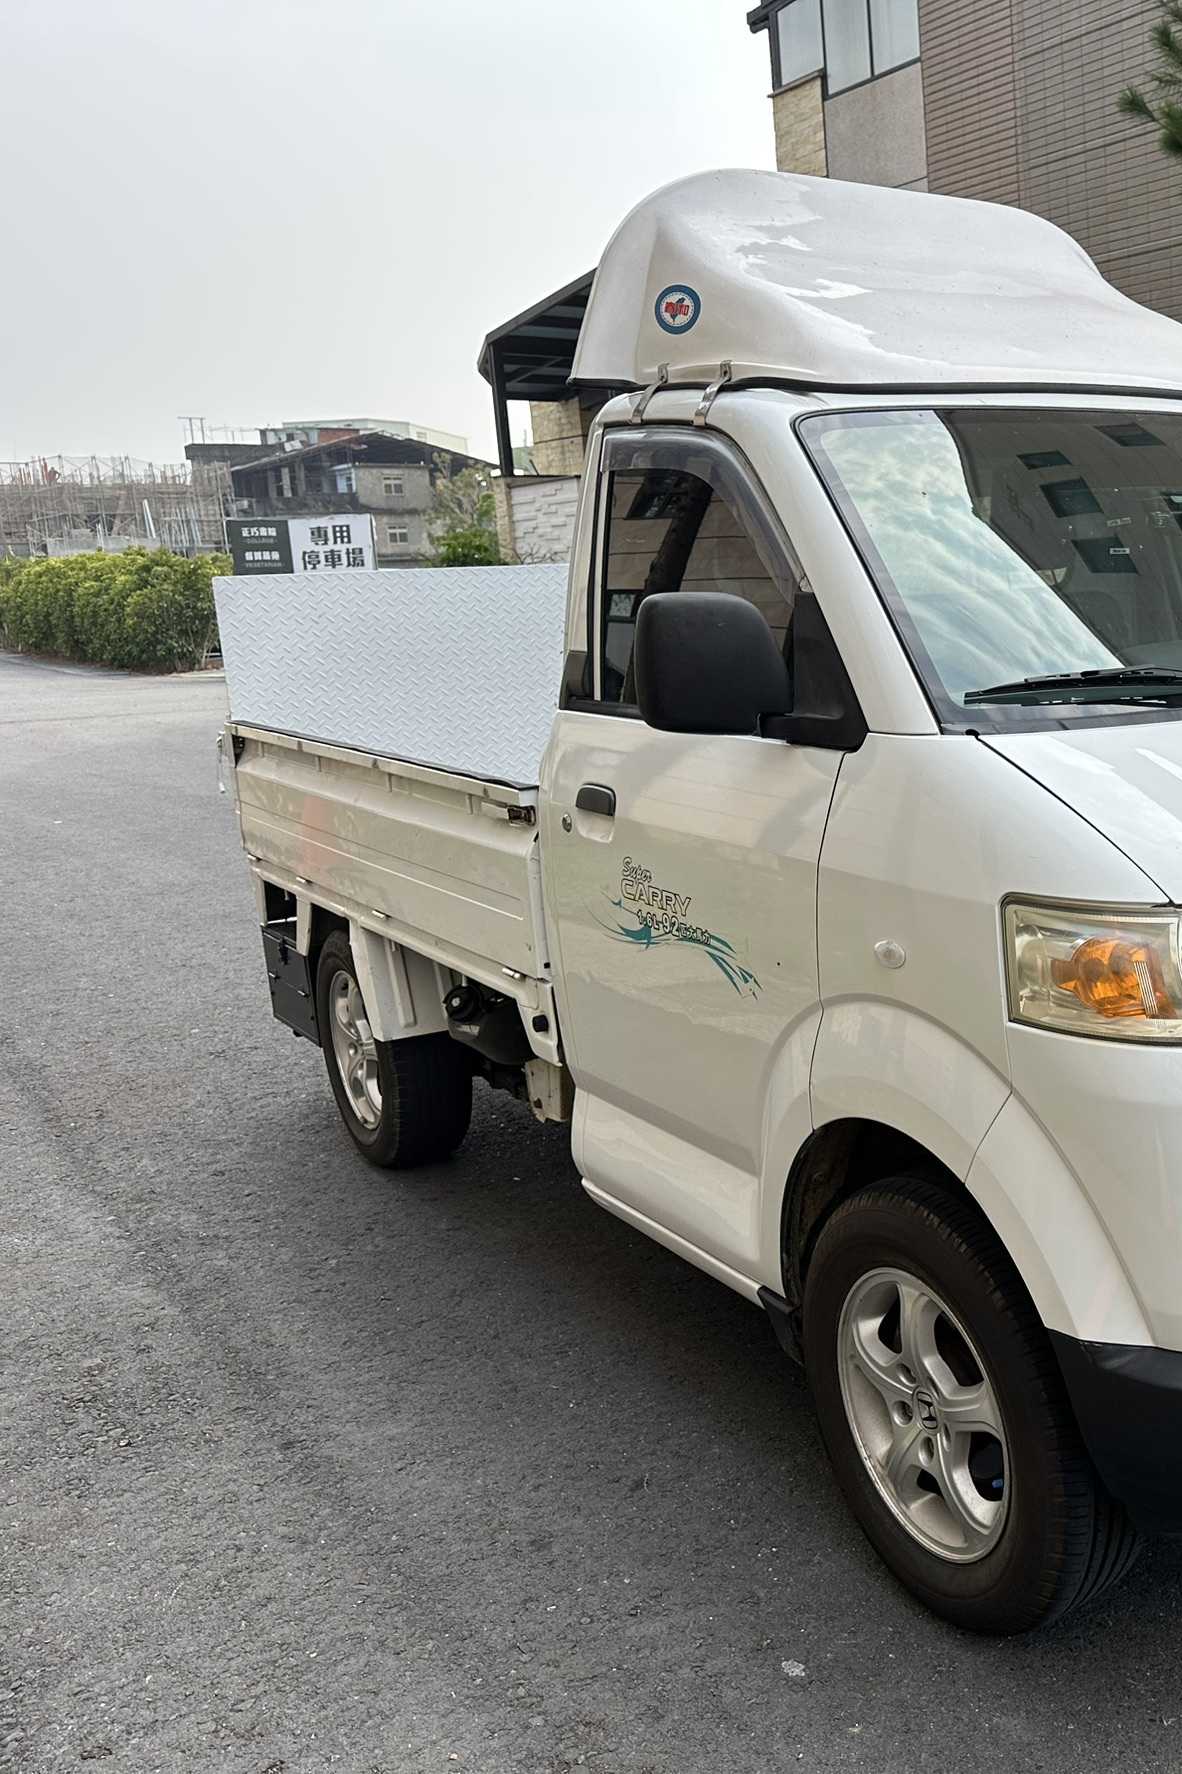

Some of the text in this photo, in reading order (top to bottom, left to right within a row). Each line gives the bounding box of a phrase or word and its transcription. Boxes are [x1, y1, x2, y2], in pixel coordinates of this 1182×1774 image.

[309, 524, 352, 546] 專用
[302, 547, 365, 570] 停車場
[621, 878, 691, 917] CARRY
